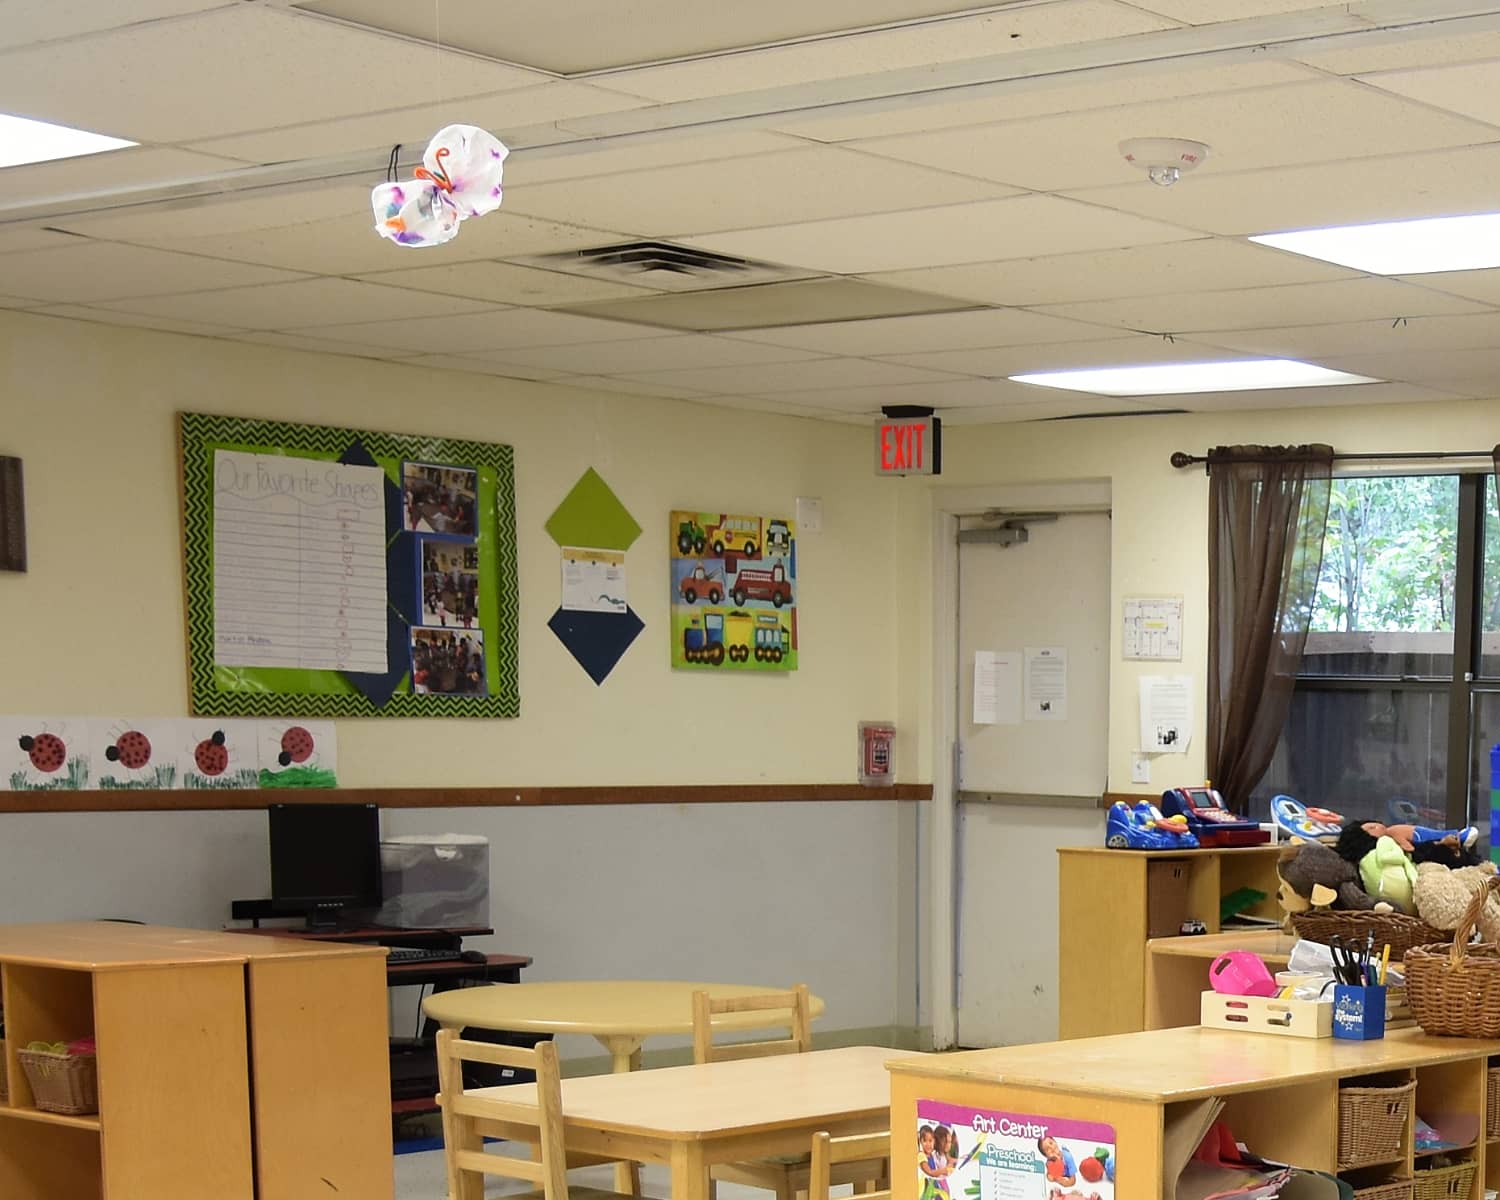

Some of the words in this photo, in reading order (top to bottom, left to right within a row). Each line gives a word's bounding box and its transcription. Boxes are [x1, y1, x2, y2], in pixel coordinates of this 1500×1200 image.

[881, 424, 927, 469] EXIT
[217, 458, 252, 491] Our
[256, 461, 319, 494] Favorite
[324, 469, 378, 502] Shapes
[973, 1114, 996, 1133] Art
[1000, 1118, 1048, 1139] Center
[986, 1144, 1035, 1162] Preschool
